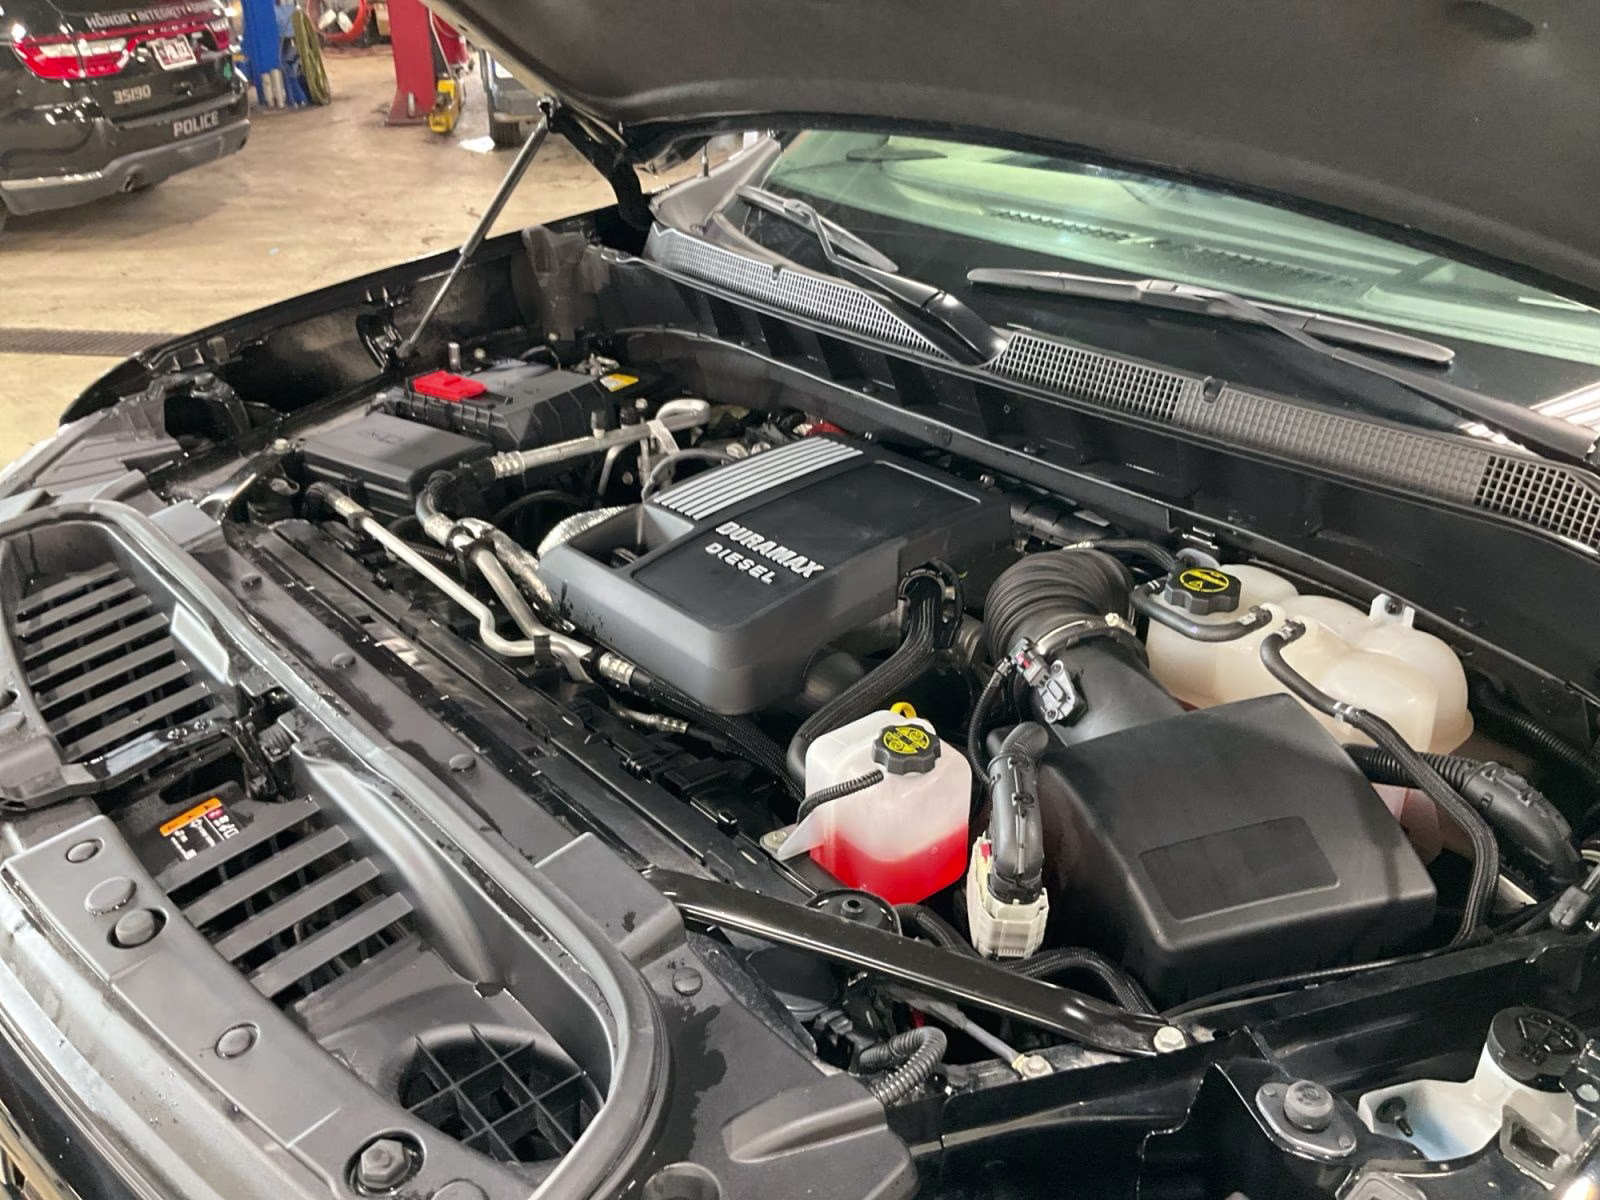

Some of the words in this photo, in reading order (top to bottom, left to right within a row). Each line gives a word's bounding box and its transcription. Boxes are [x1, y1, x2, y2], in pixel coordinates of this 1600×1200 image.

[85, 13, 131, 29] HONOR
[173, 111, 219, 137] POLICE
[705, 542, 776, 585] DIESEL
[716, 521, 825, 578] DURAMAX
